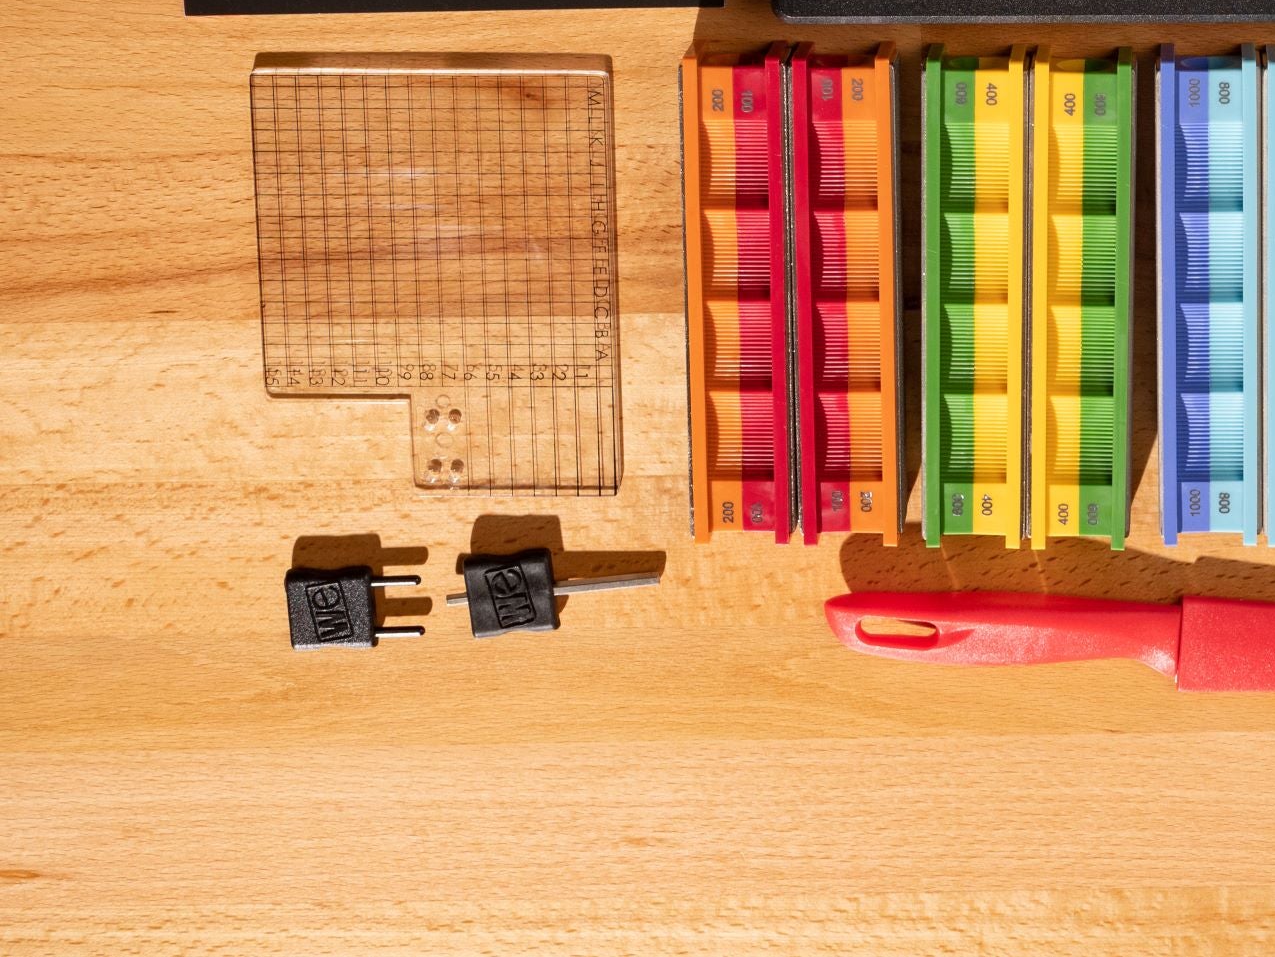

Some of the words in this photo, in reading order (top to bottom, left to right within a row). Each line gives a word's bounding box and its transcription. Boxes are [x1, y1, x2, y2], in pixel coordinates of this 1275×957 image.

[587, 91, 601, 106] M
[852, 78, 863, 101] 200
[986, 82, 997, 106] 400
[1188, 79, 1200, 107] 1000
[1218, 82, 1230, 105] 800
[1064, 93, 1076, 116] 400
[589, 137, 603, 146] K
[591, 201, 604, 211] H
[592, 220, 606, 234] G
[594, 286, 608, 297] D
[594, 306, 609, 319] C
[595, 329, 608, 339] B
[595, 349, 608, 361] A
[722, 501, 734, 523] 200
[982, 494, 993, 516] 400
[1189, 489, 1200, 516] 1000
[1218, 492, 1230, 514] 800
[1058, 503, 1069, 525] 400
